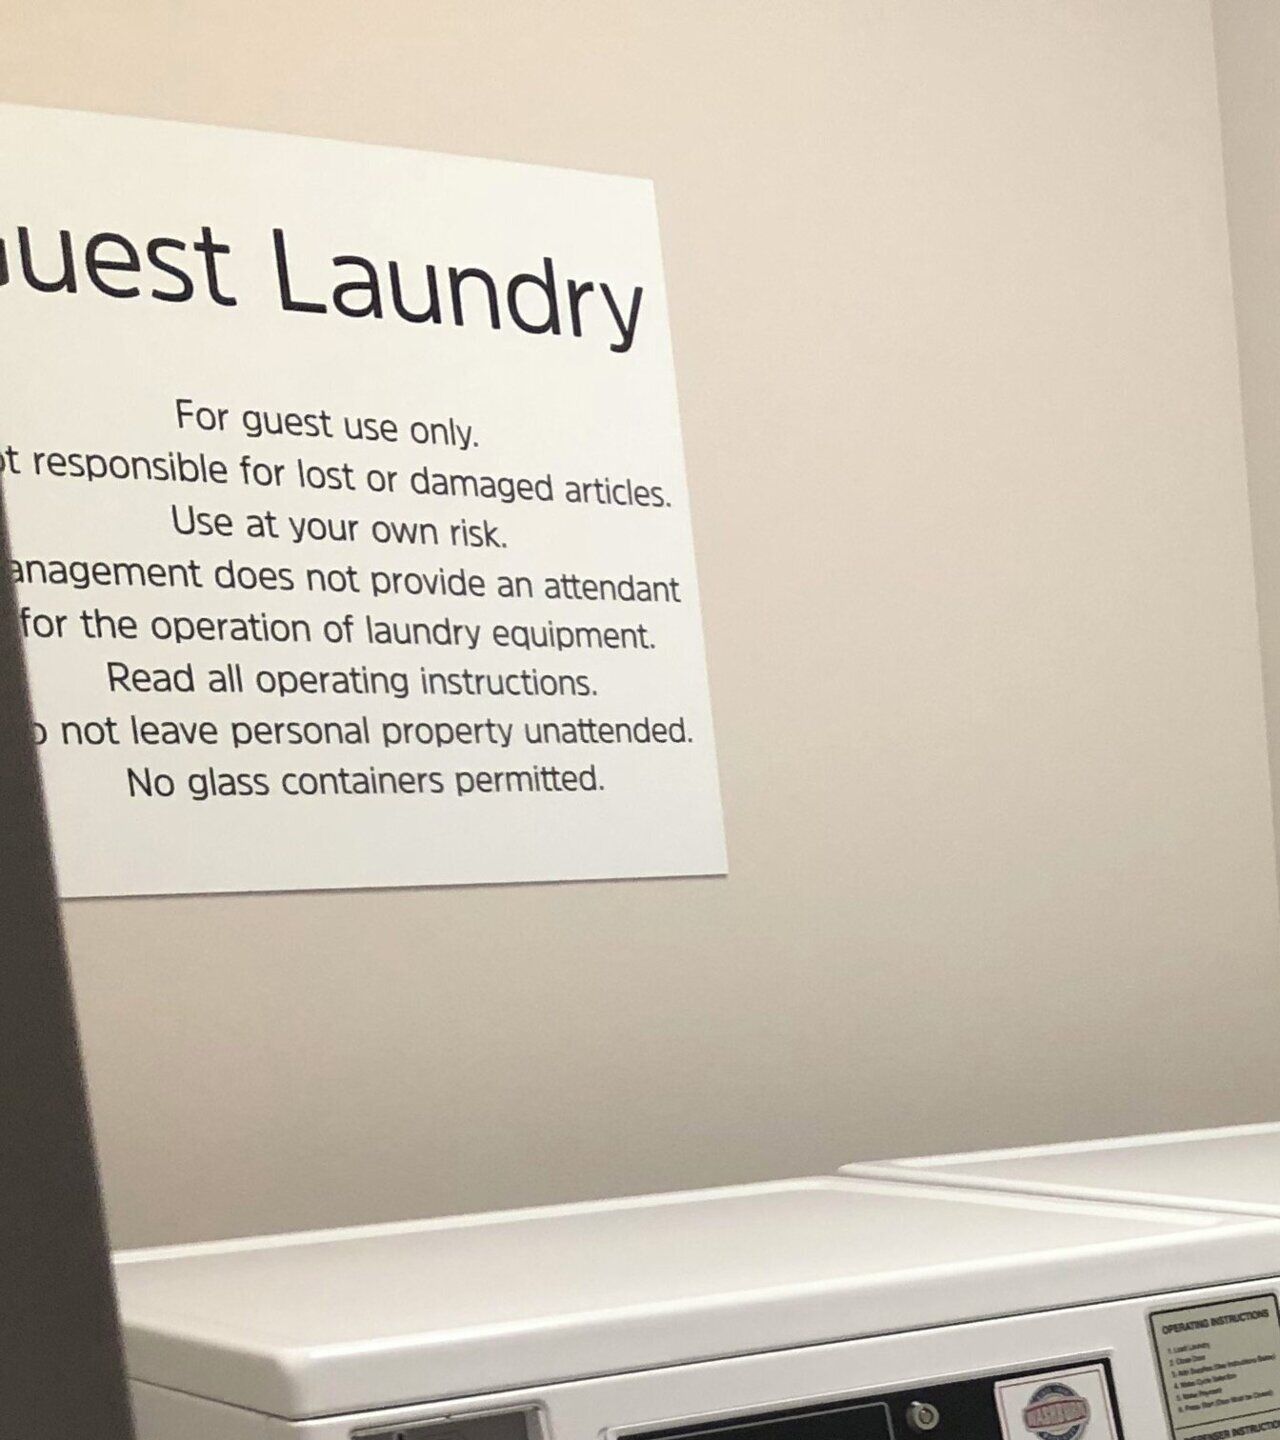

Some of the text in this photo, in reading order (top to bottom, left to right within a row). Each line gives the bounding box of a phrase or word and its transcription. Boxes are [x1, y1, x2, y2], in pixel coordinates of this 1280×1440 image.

[0, 226, 643, 353] uest Laundry
[176, 399, 479, 451] For guest use only.
[34, 451, 227, 483] responsible
[239, 455, 285, 486] for
[298, 459, 356, 492] lost
[367, 470, 397, 493] or
[410, 466, 553, 505] damaged
[566, 478, 672, 508] articles.
[172, 504, 507, 548] Use at your own risk.
[12, 560, 681, 603] anagement does not provide an attendant
[22, 608, 655, 652] for the operation of laundry equipment.
[107, 662, 597, 698] Read all operating instructions.
[33, 715, 693, 749] o not leave personal property unattended.
[127, 764, 604, 802] No glass containers permitted.
[1162, 1309, 1269, 1335] OPERATING INSTRUCTIONS
